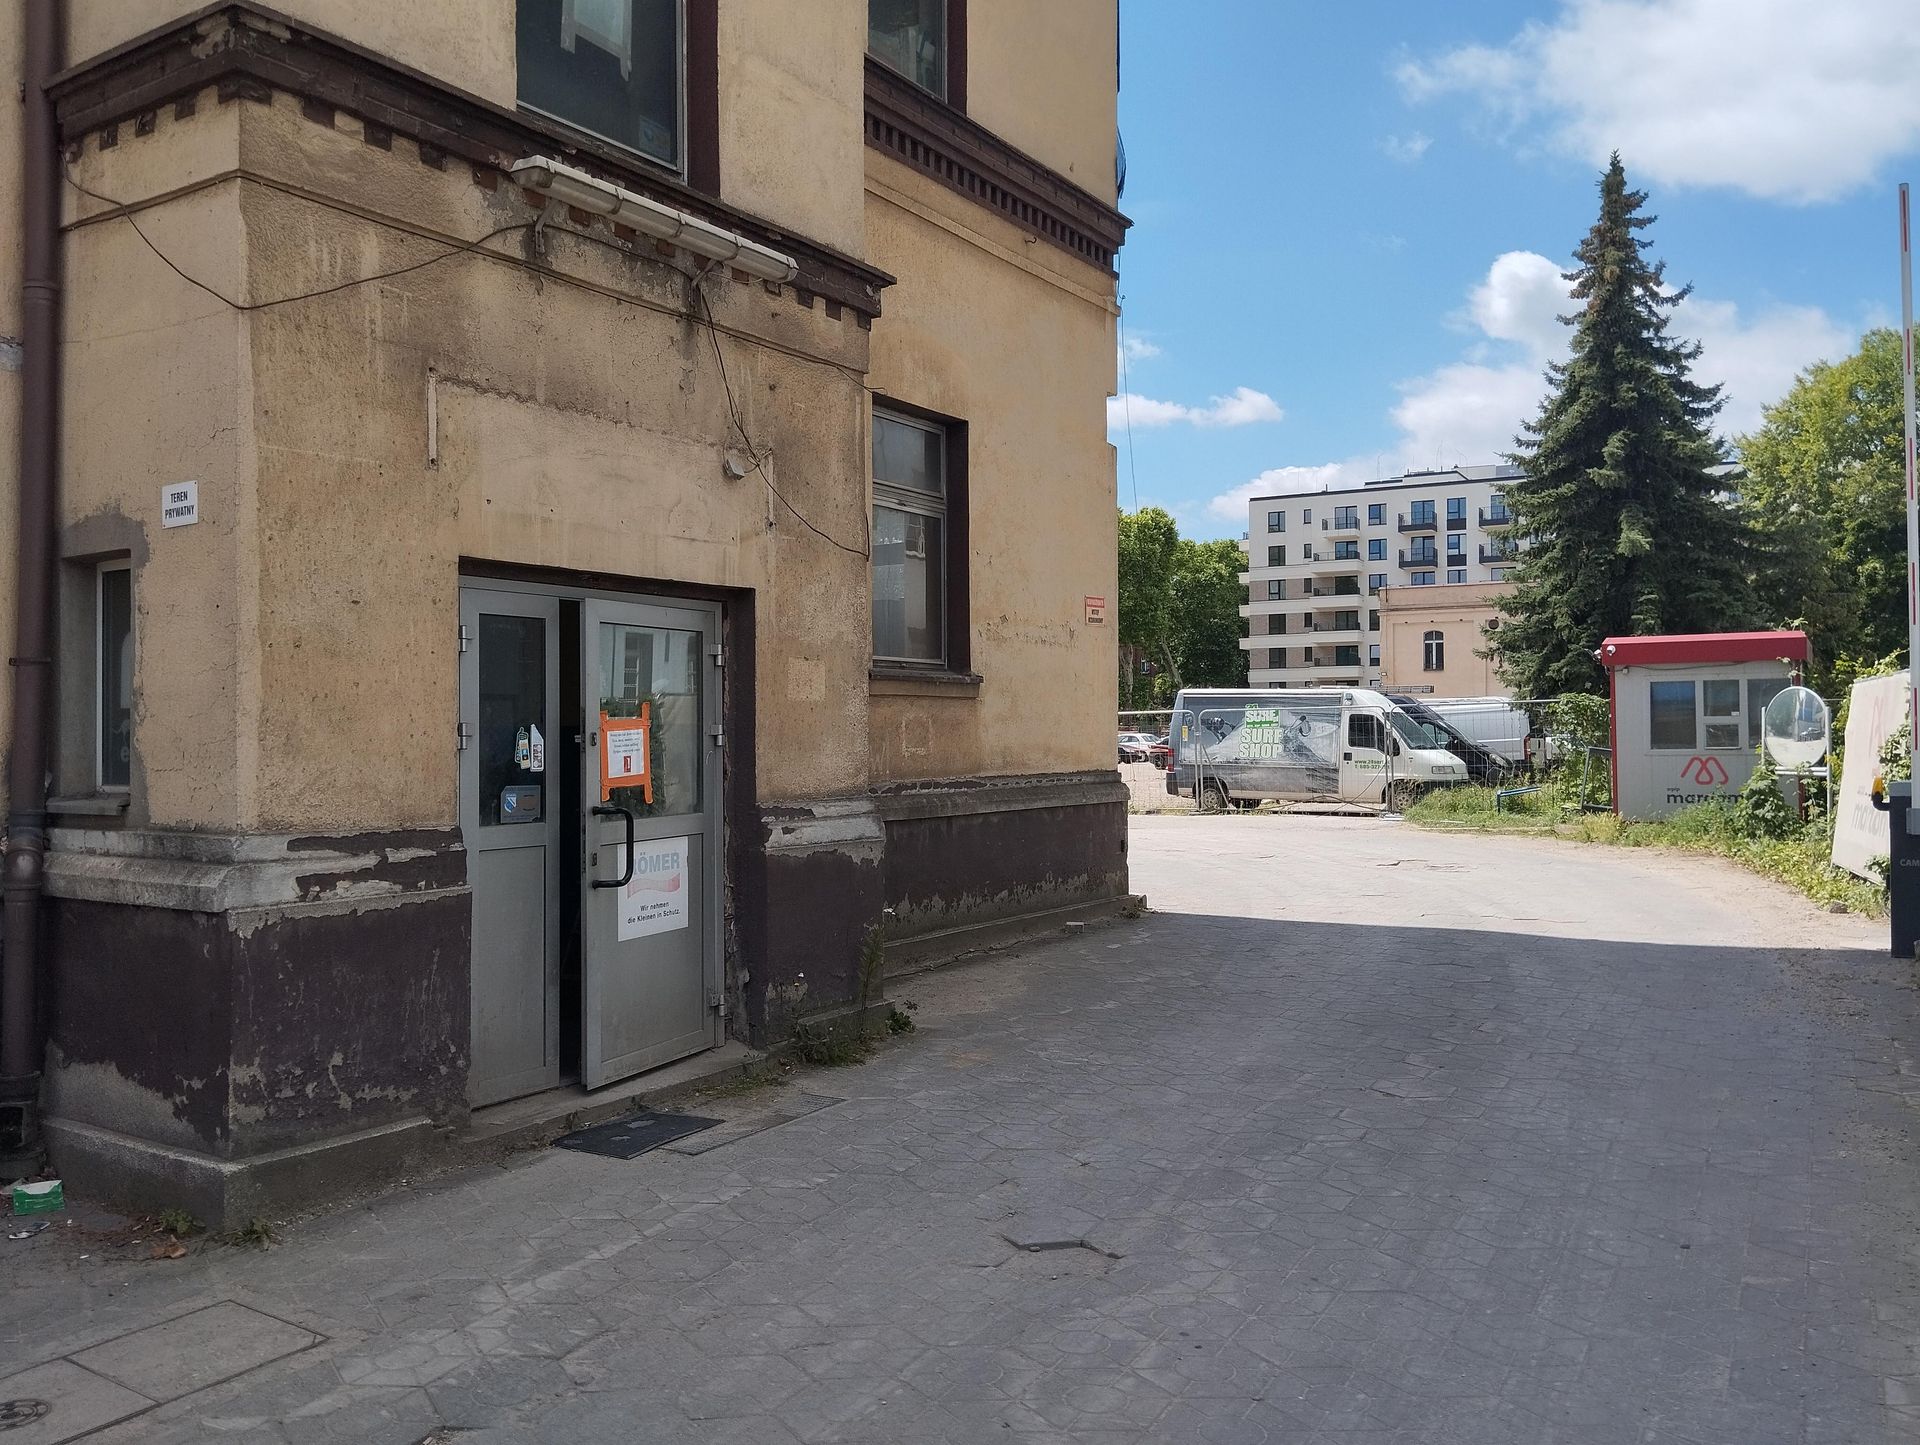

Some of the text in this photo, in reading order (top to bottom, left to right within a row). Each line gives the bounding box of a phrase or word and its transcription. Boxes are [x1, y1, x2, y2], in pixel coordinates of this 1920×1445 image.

[170, 490, 188, 503] TEREN
[164, 505, 195, 519] PRYWATNY
[1241, 728, 1283, 743] SURF
[1239, 743, 1283, 758] SHOP
[640, 901, 670, 912] Wir nehmen
[637, 912, 656, 922] Kleinen
